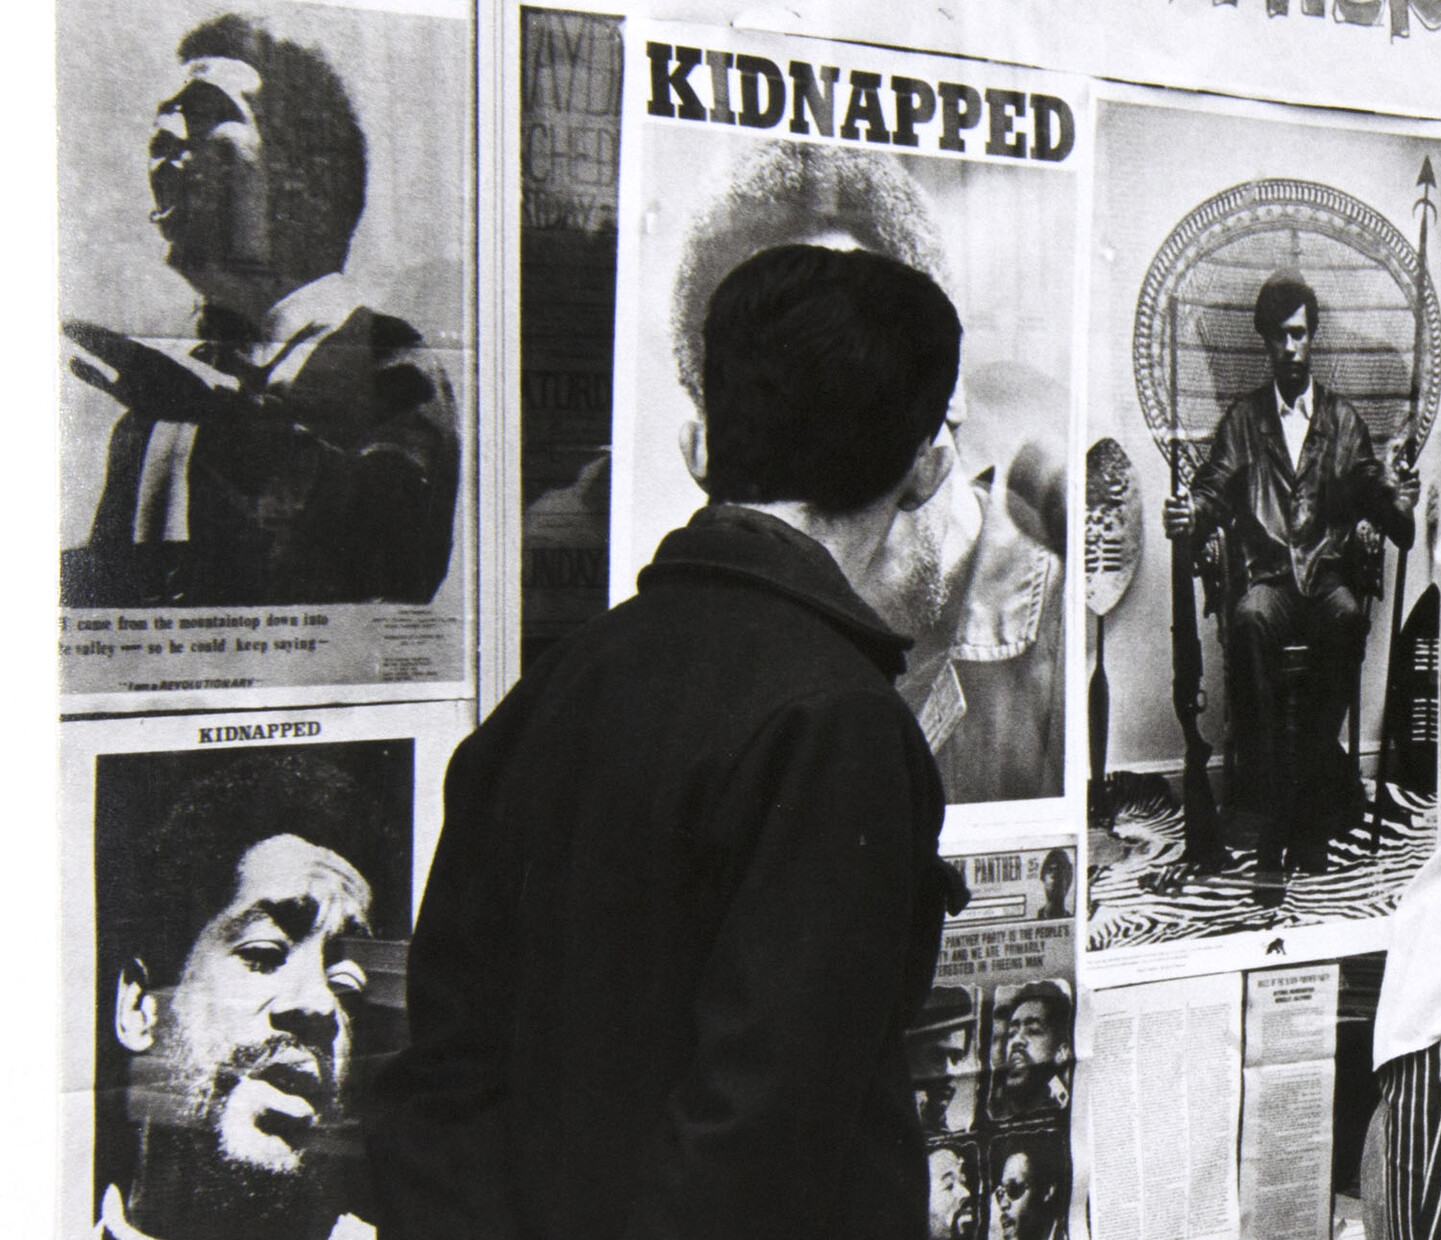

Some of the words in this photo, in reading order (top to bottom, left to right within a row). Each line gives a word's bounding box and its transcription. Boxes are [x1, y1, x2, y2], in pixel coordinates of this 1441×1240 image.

[646, 40, 1075, 162] KIDNAPPED
[77, 618, 111, 632] came
[117, 615, 148, 631] from
[153, 615, 173, 630] the
[178, 614, 261, 631] mountaintop
[265, 612, 298, 628] down
[303, 613, 329, 627] into
[147, 643, 163, 655] so
[168, 639, 184, 655] he
[190, 638, 227, 654] could
[234, 637, 269, 654] keep
[198, 721, 321, 744] KIDNAPPED
[974, 856, 1022, 885] PANTHER
[945, 933, 980, 949] PANTHER
[982, 931, 1007, 946] PARTY
[1008, 930, 1017, 943] IS
[1020, 928, 1034, 941] THE
[951, 949, 969, 962] AND
[970, 947, 984, 960] WE
[986, 945, 1000, 959] ARE
